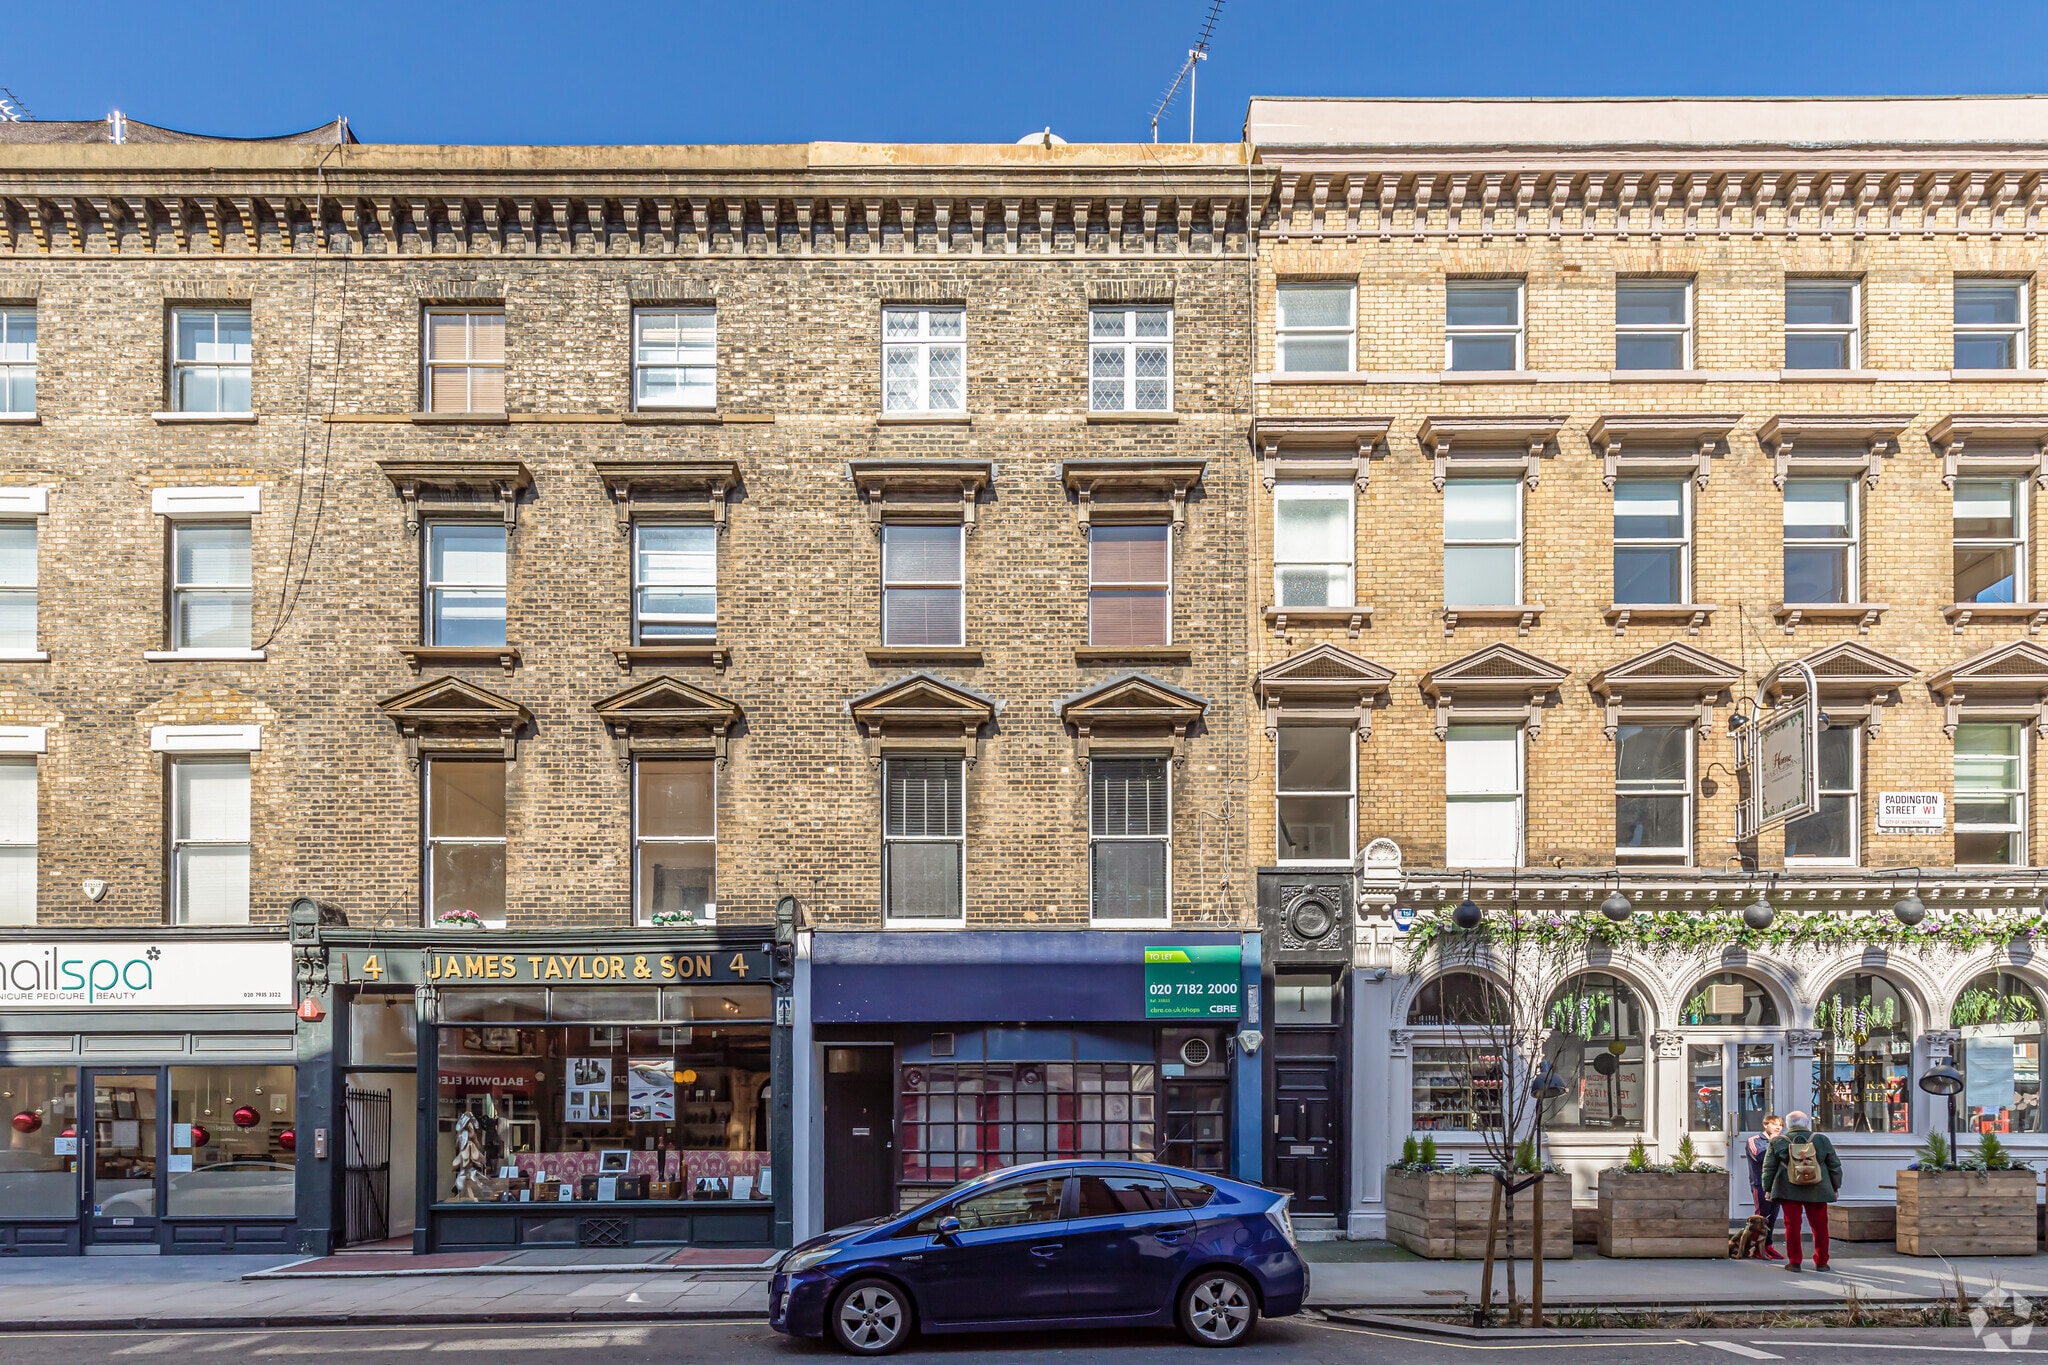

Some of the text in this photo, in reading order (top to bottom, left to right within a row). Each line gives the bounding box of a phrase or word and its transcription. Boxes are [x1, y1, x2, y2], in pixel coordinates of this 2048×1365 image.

[1885, 795, 1938, 804] PADDINGTON
[1885, 806, 1936, 815] STREET W1
[362, 952, 749, 980] 4 JAMES TAYLOR & SON 4
[0, 946, 152, 1004] ailspa
[1149, 983, 1238, 995] 020 7182 2000
[36, 992, 85, 1000] PEDICURE
[96, 992, 137, 1000] BEAUTY
[1150, 1005, 1237, 1014] cbre.co.uk/shops CBRE
